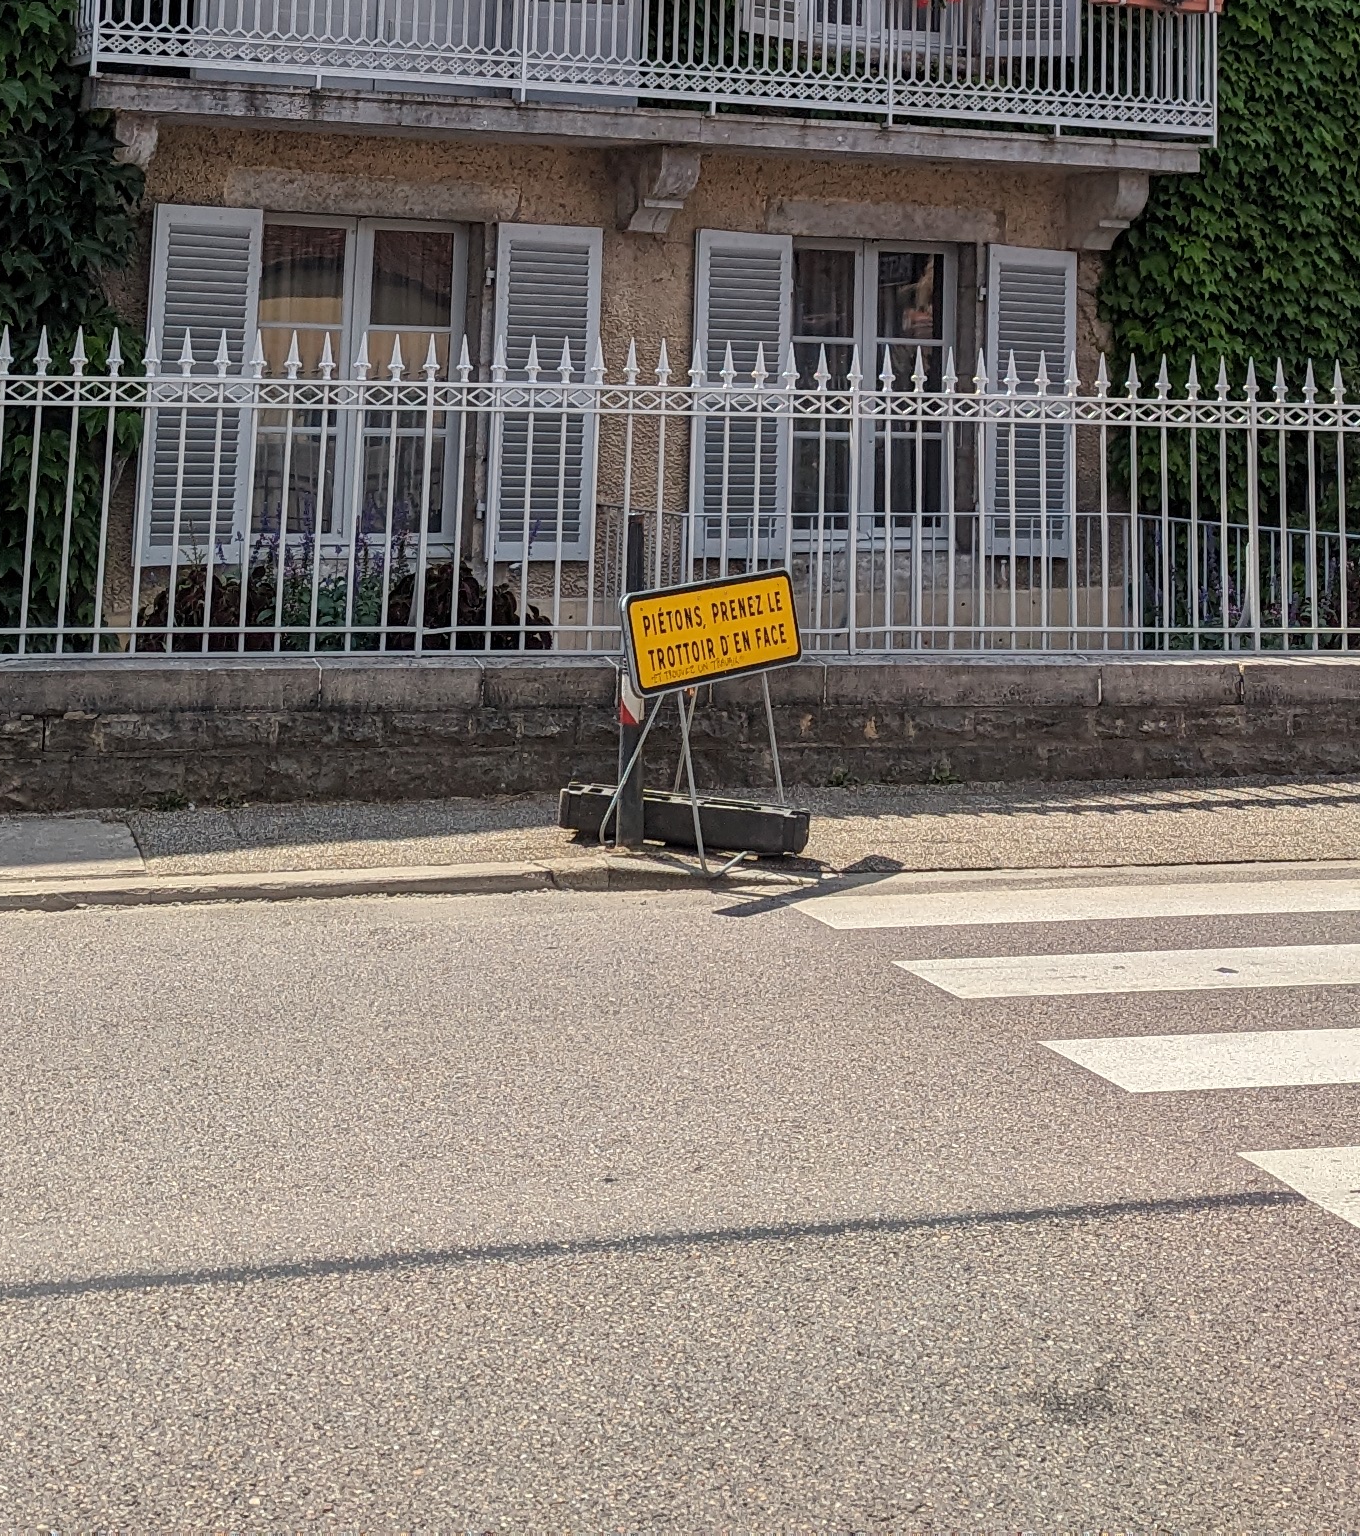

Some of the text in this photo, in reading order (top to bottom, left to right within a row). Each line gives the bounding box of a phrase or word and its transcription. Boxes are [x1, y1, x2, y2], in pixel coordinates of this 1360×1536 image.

[642, 590, 784, 638] PIÉTONS, PRENEZ LE
[647, 622, 788, 672] TROTTOIR D'EN FACE
